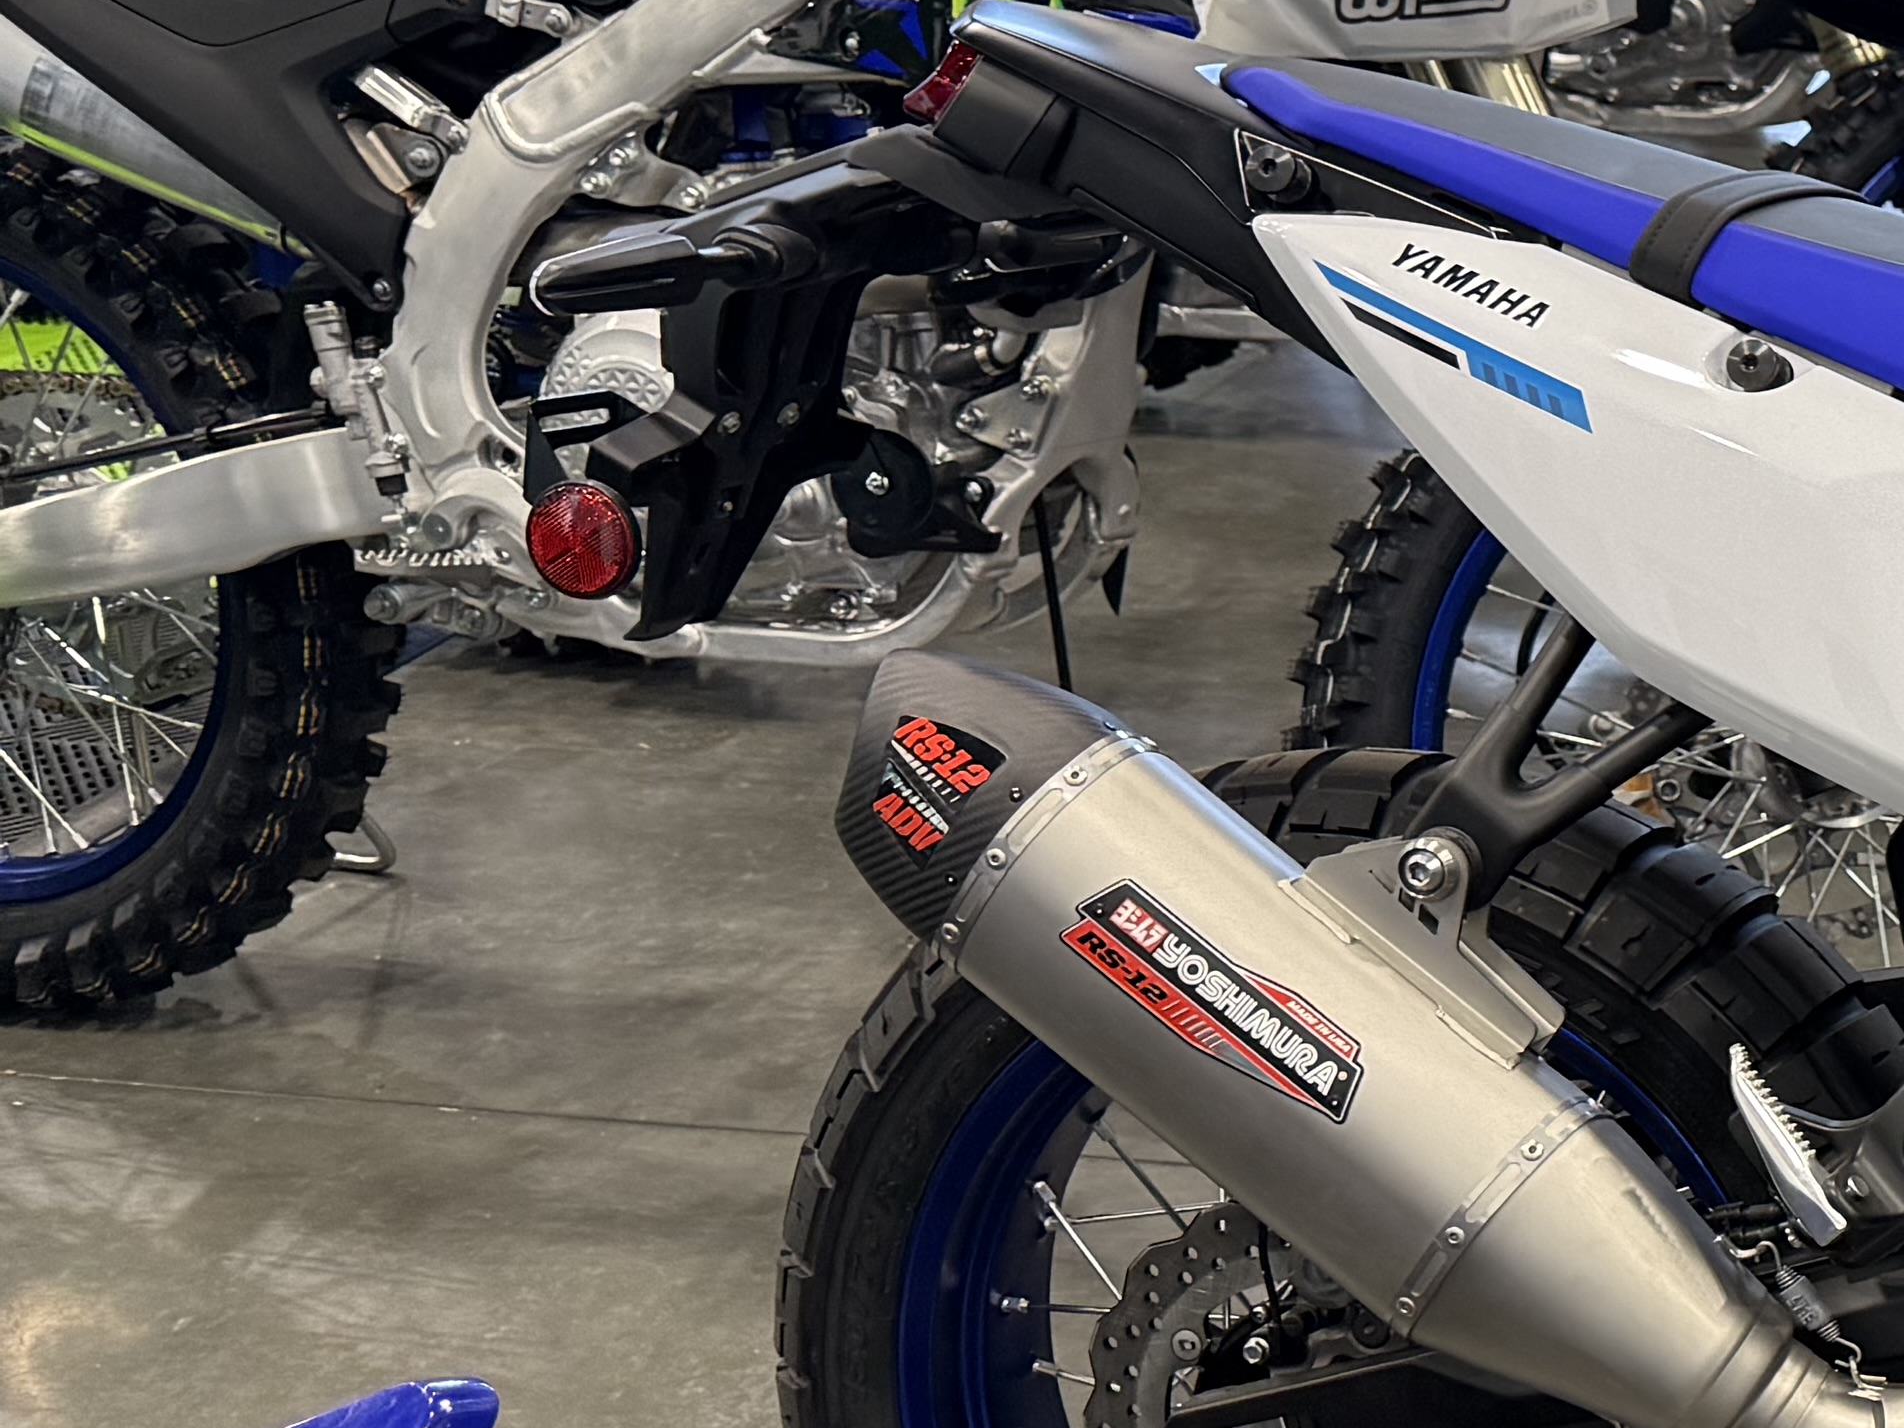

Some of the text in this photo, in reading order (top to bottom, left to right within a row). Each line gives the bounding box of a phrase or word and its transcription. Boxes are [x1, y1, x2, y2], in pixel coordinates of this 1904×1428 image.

[1391, 243, 1551, 328] YAMAHA
[872, 792, 944, 852] ADV
[1076, 930, 1169, 1006] RS-12
[1152, 933, 1339, 1096] YOSHIMURA
[1286, 1000, 1318, 1025] MADE
